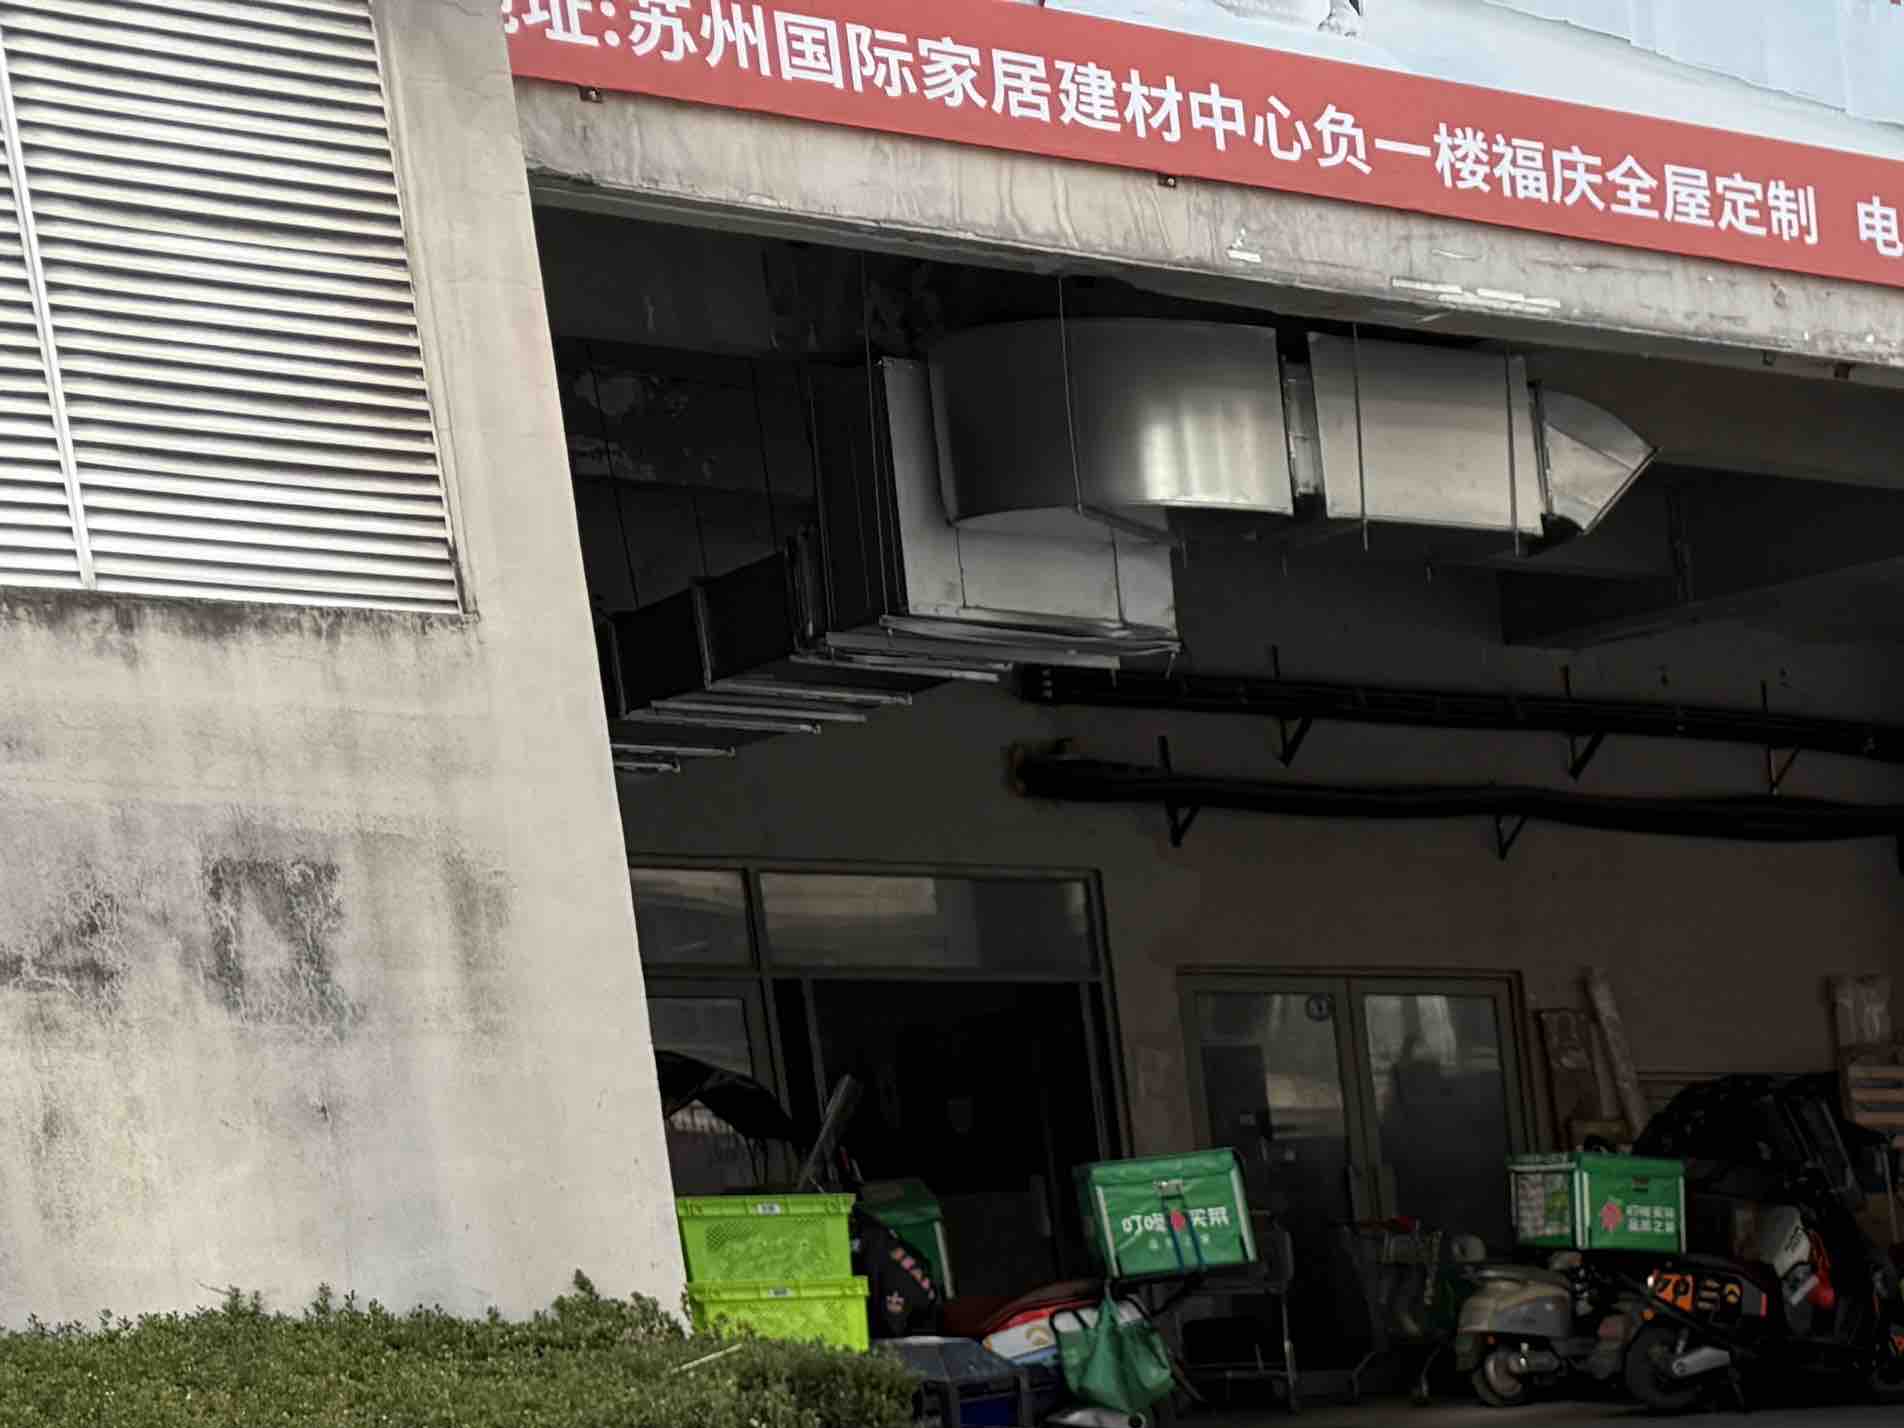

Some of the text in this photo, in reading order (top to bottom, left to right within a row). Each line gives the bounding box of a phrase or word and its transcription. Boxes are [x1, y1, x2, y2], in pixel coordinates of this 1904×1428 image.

[502, 0, 1819, 245] 址:苏州国际家居建材中心负一楼福庆全屋定制
